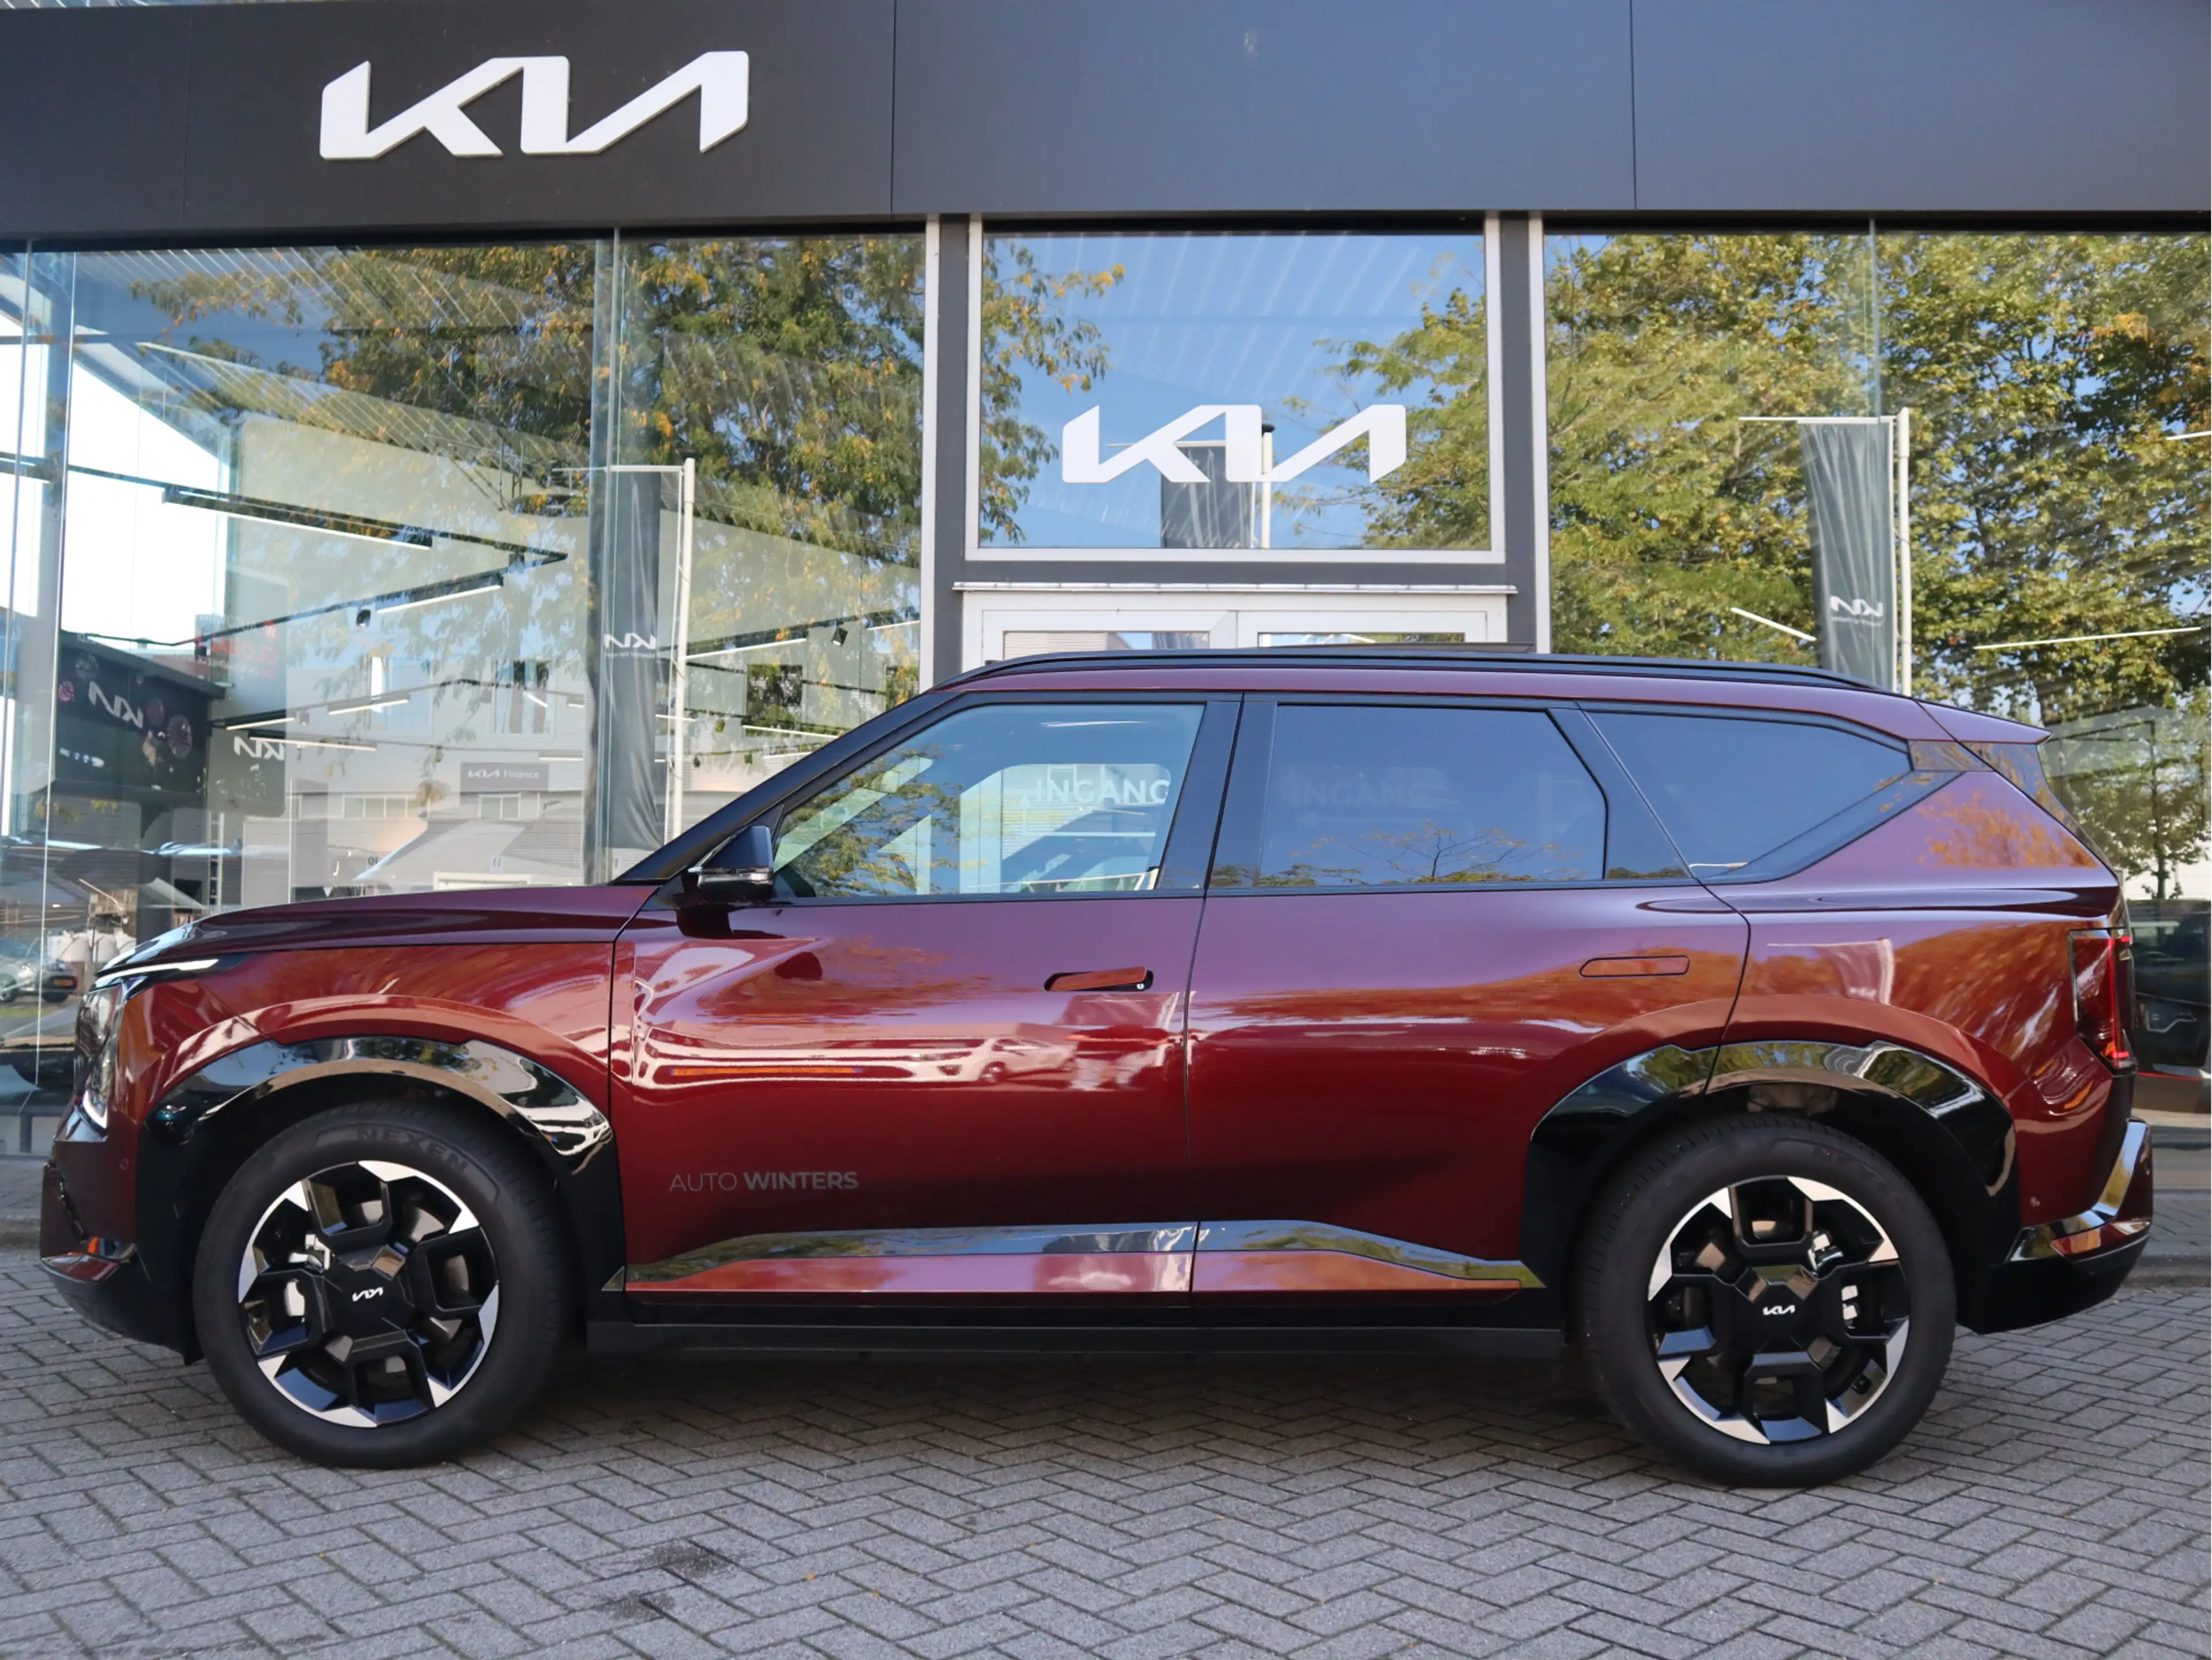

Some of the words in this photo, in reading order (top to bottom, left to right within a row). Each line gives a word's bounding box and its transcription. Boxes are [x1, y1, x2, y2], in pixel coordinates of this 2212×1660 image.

[319, 51, 749, 159] KIA
[1062, 404, 1406, 483] KIA
[357, 1127, 469, 1169] NEXEN
[669, 1172, 738, 1192] AUTO
[743, 1171, 859, 1190] WINTERS
[352, 1286, 383, 1301] KIA
[1762, 1305, 1796, 1315] KIA
